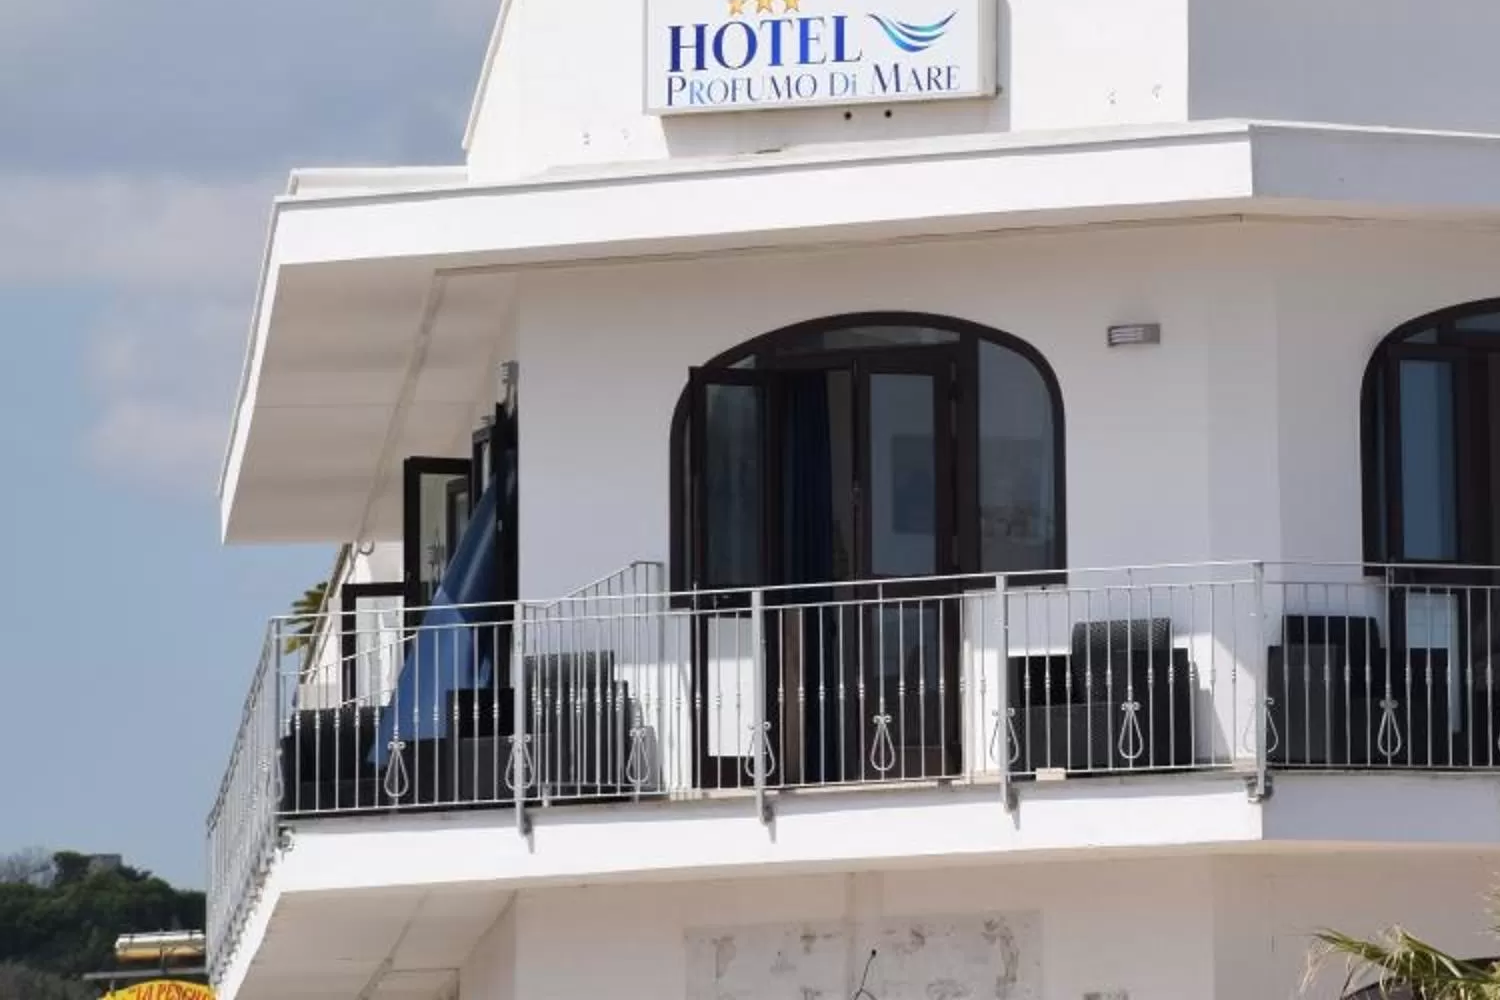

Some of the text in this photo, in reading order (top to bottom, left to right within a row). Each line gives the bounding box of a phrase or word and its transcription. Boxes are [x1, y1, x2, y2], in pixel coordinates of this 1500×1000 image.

[668, 15, 863, 73] HOTEL
[667, 73, 818, 106] PROFUMO
[870, 63, 961, 95] MARE
